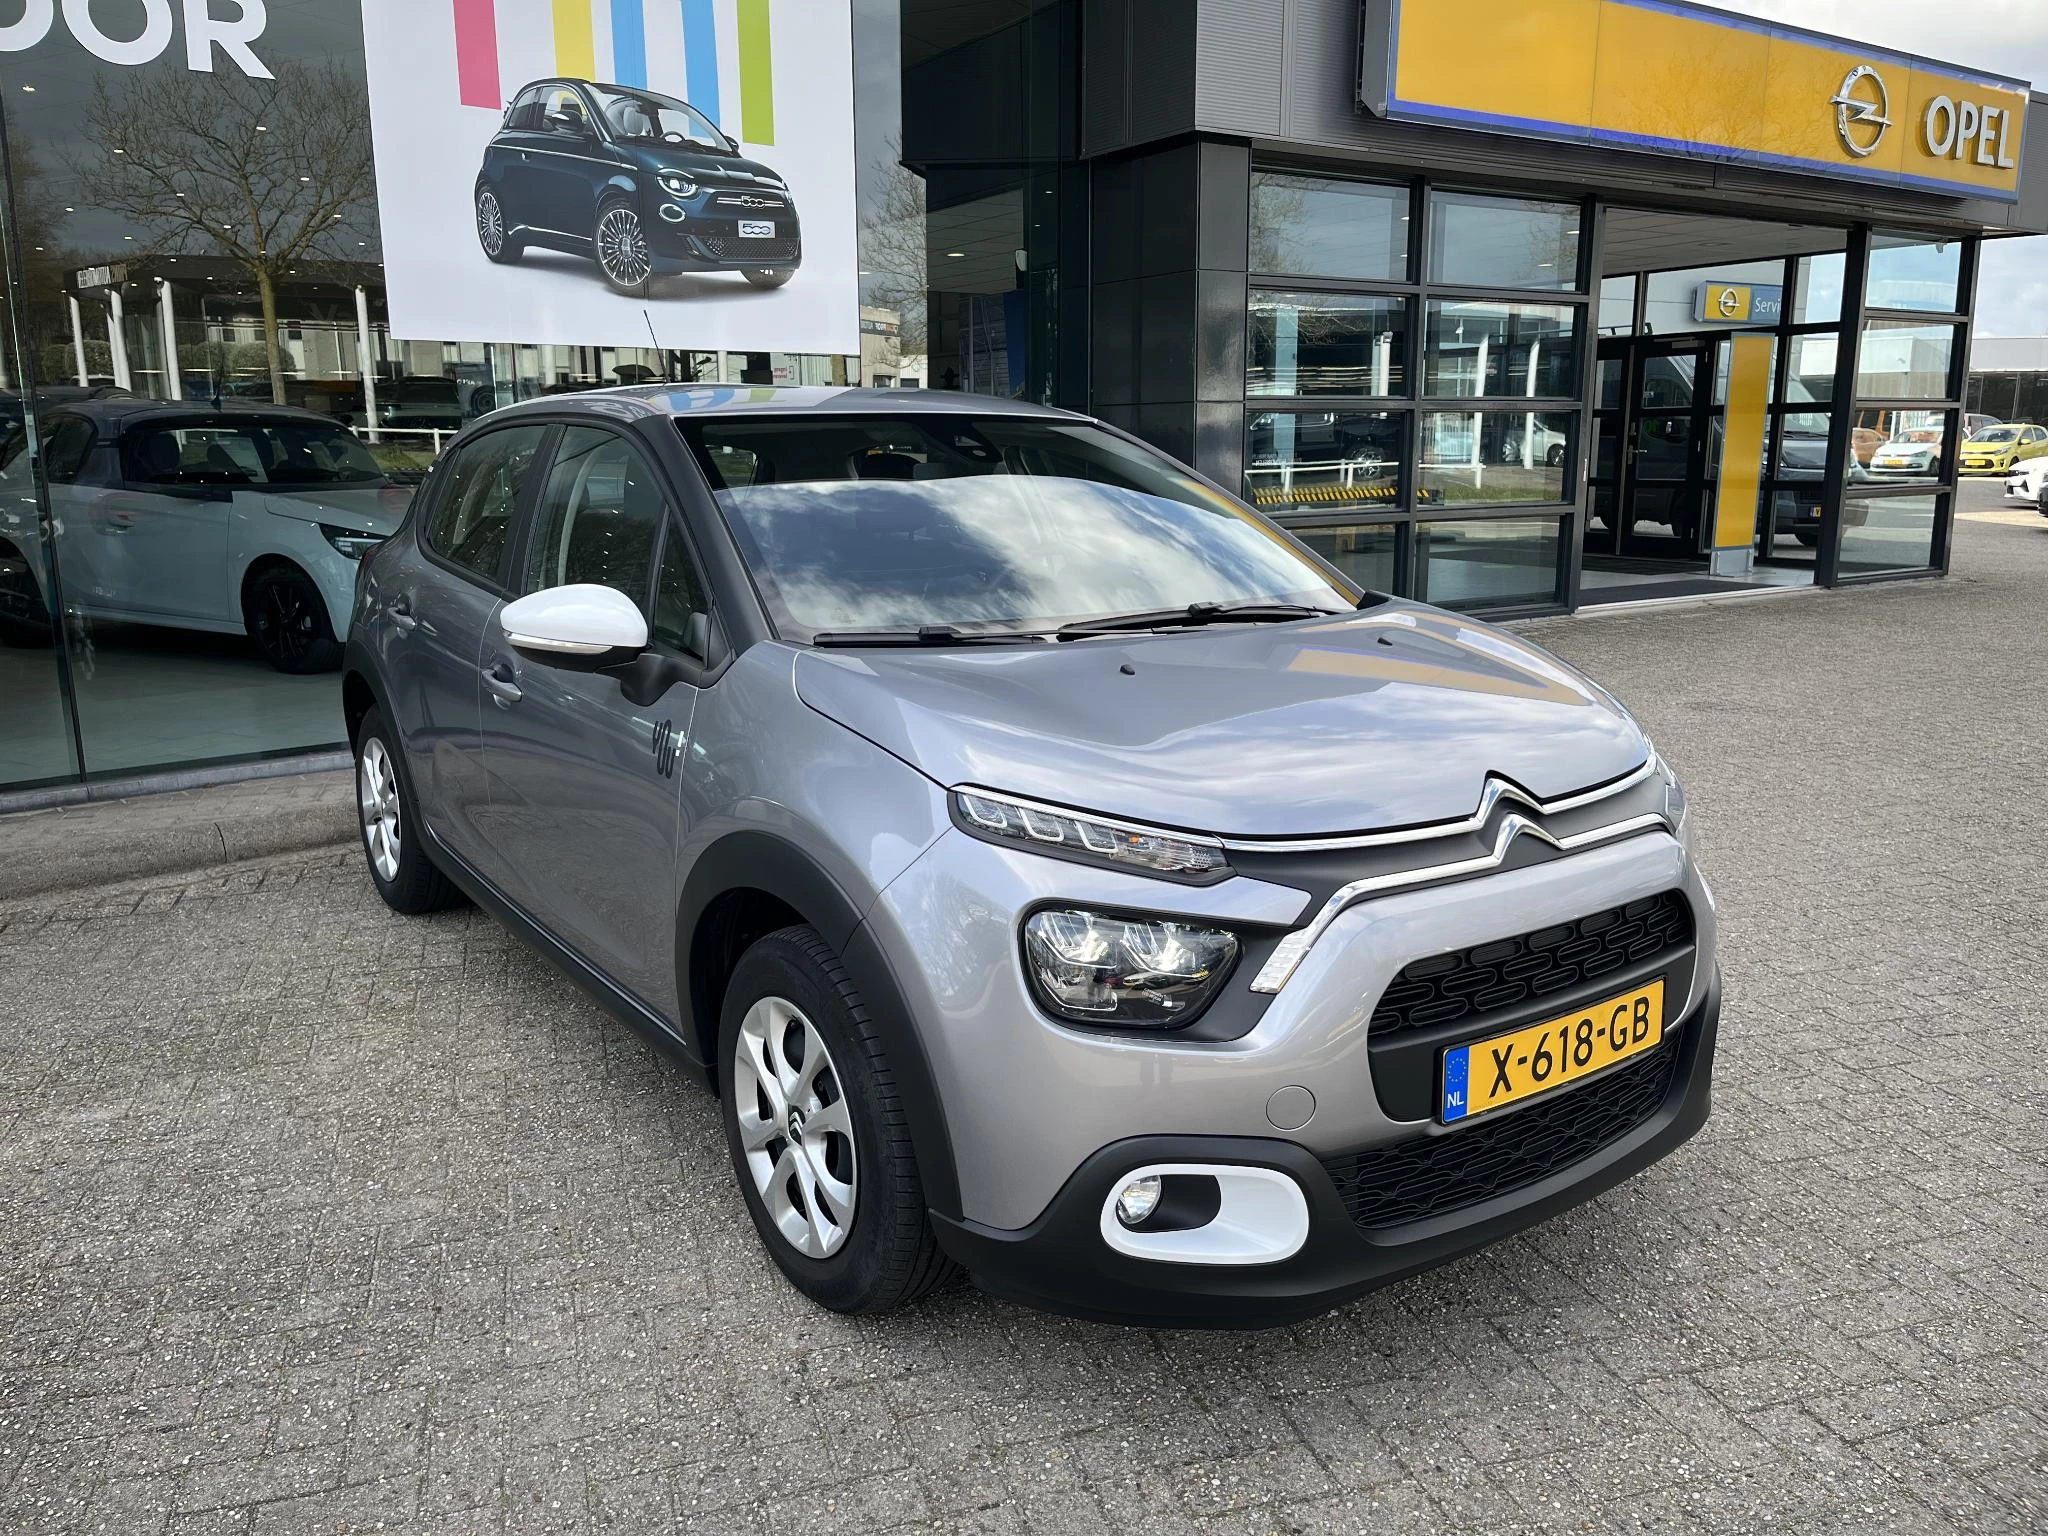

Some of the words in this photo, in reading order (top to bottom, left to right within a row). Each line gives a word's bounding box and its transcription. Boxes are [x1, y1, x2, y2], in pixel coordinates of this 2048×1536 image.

[1925, 95, 2014, 169] OPEL
[741, 195, 765, 208] 500
[743, 223, 771, 235] 500
[1489, 996, 1650, 1098] X-618-GB
[1447, 1090, 1465, 1109] NL
